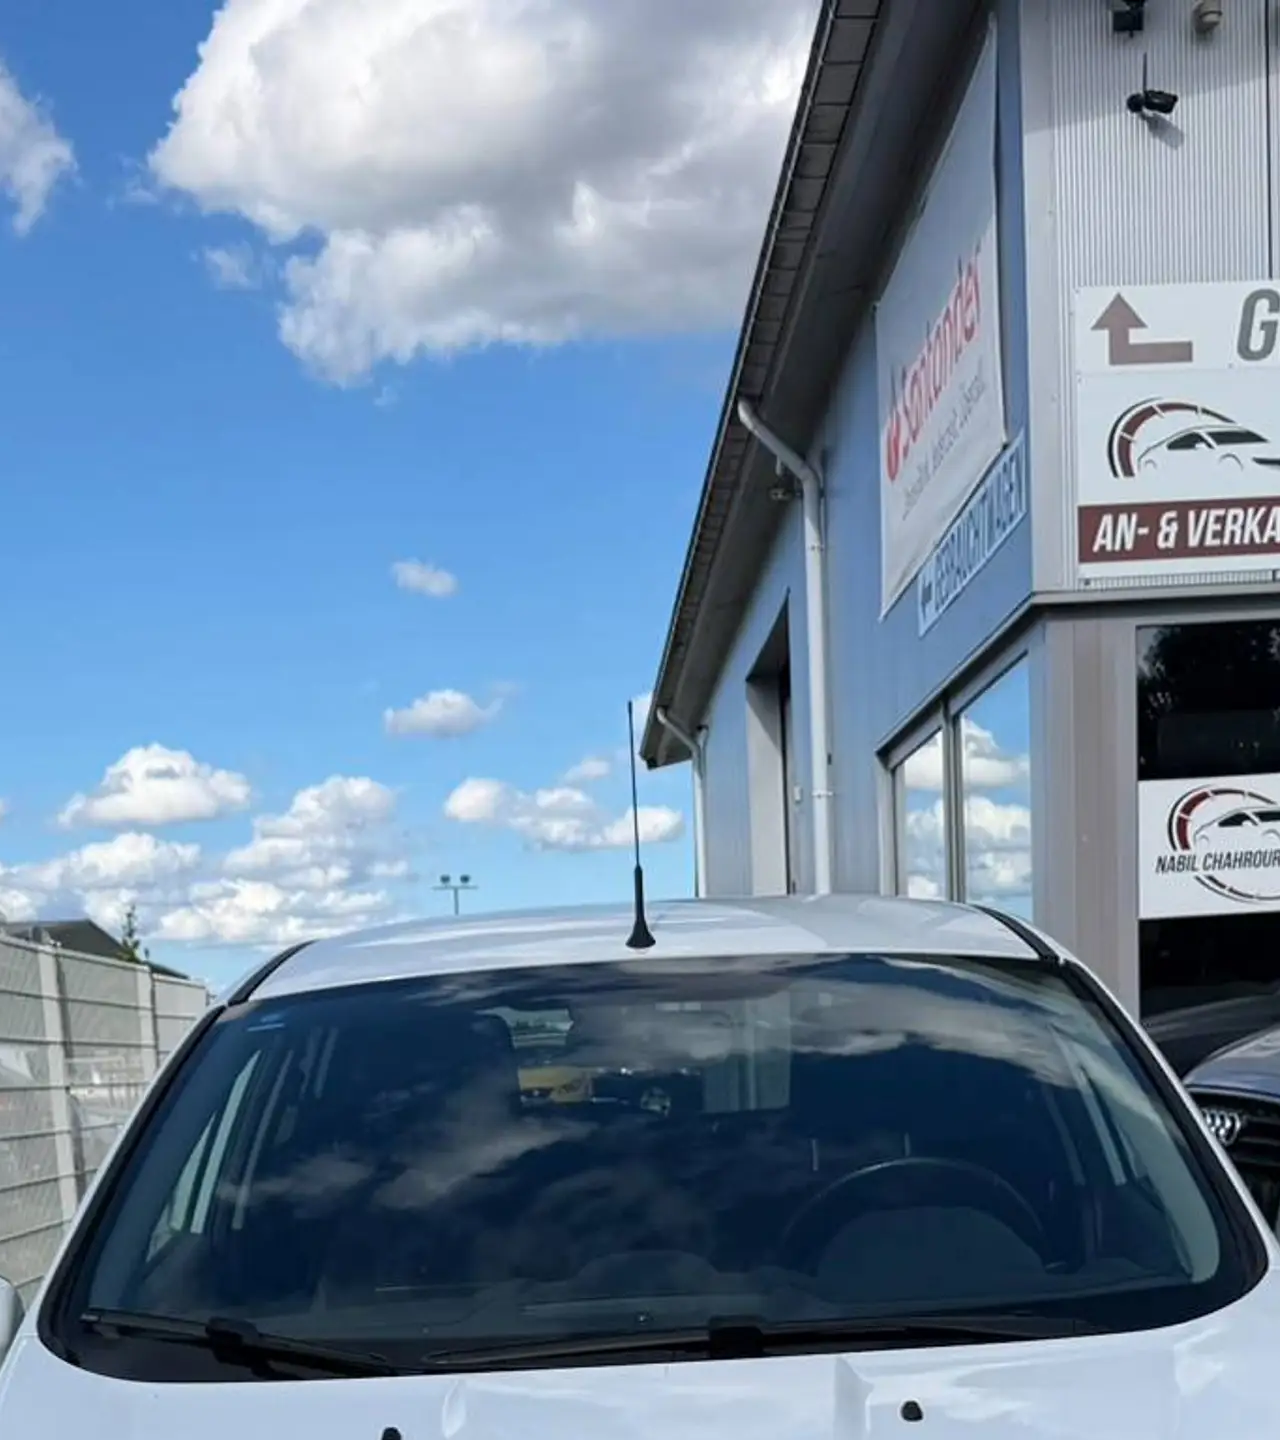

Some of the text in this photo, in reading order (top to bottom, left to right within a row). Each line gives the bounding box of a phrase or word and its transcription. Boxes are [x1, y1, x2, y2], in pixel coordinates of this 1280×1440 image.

[1093, 514, 1149, 552] AN-
[1157, 511, 1178, 549] &
[1156, 855, 1198, 874] NABIL
